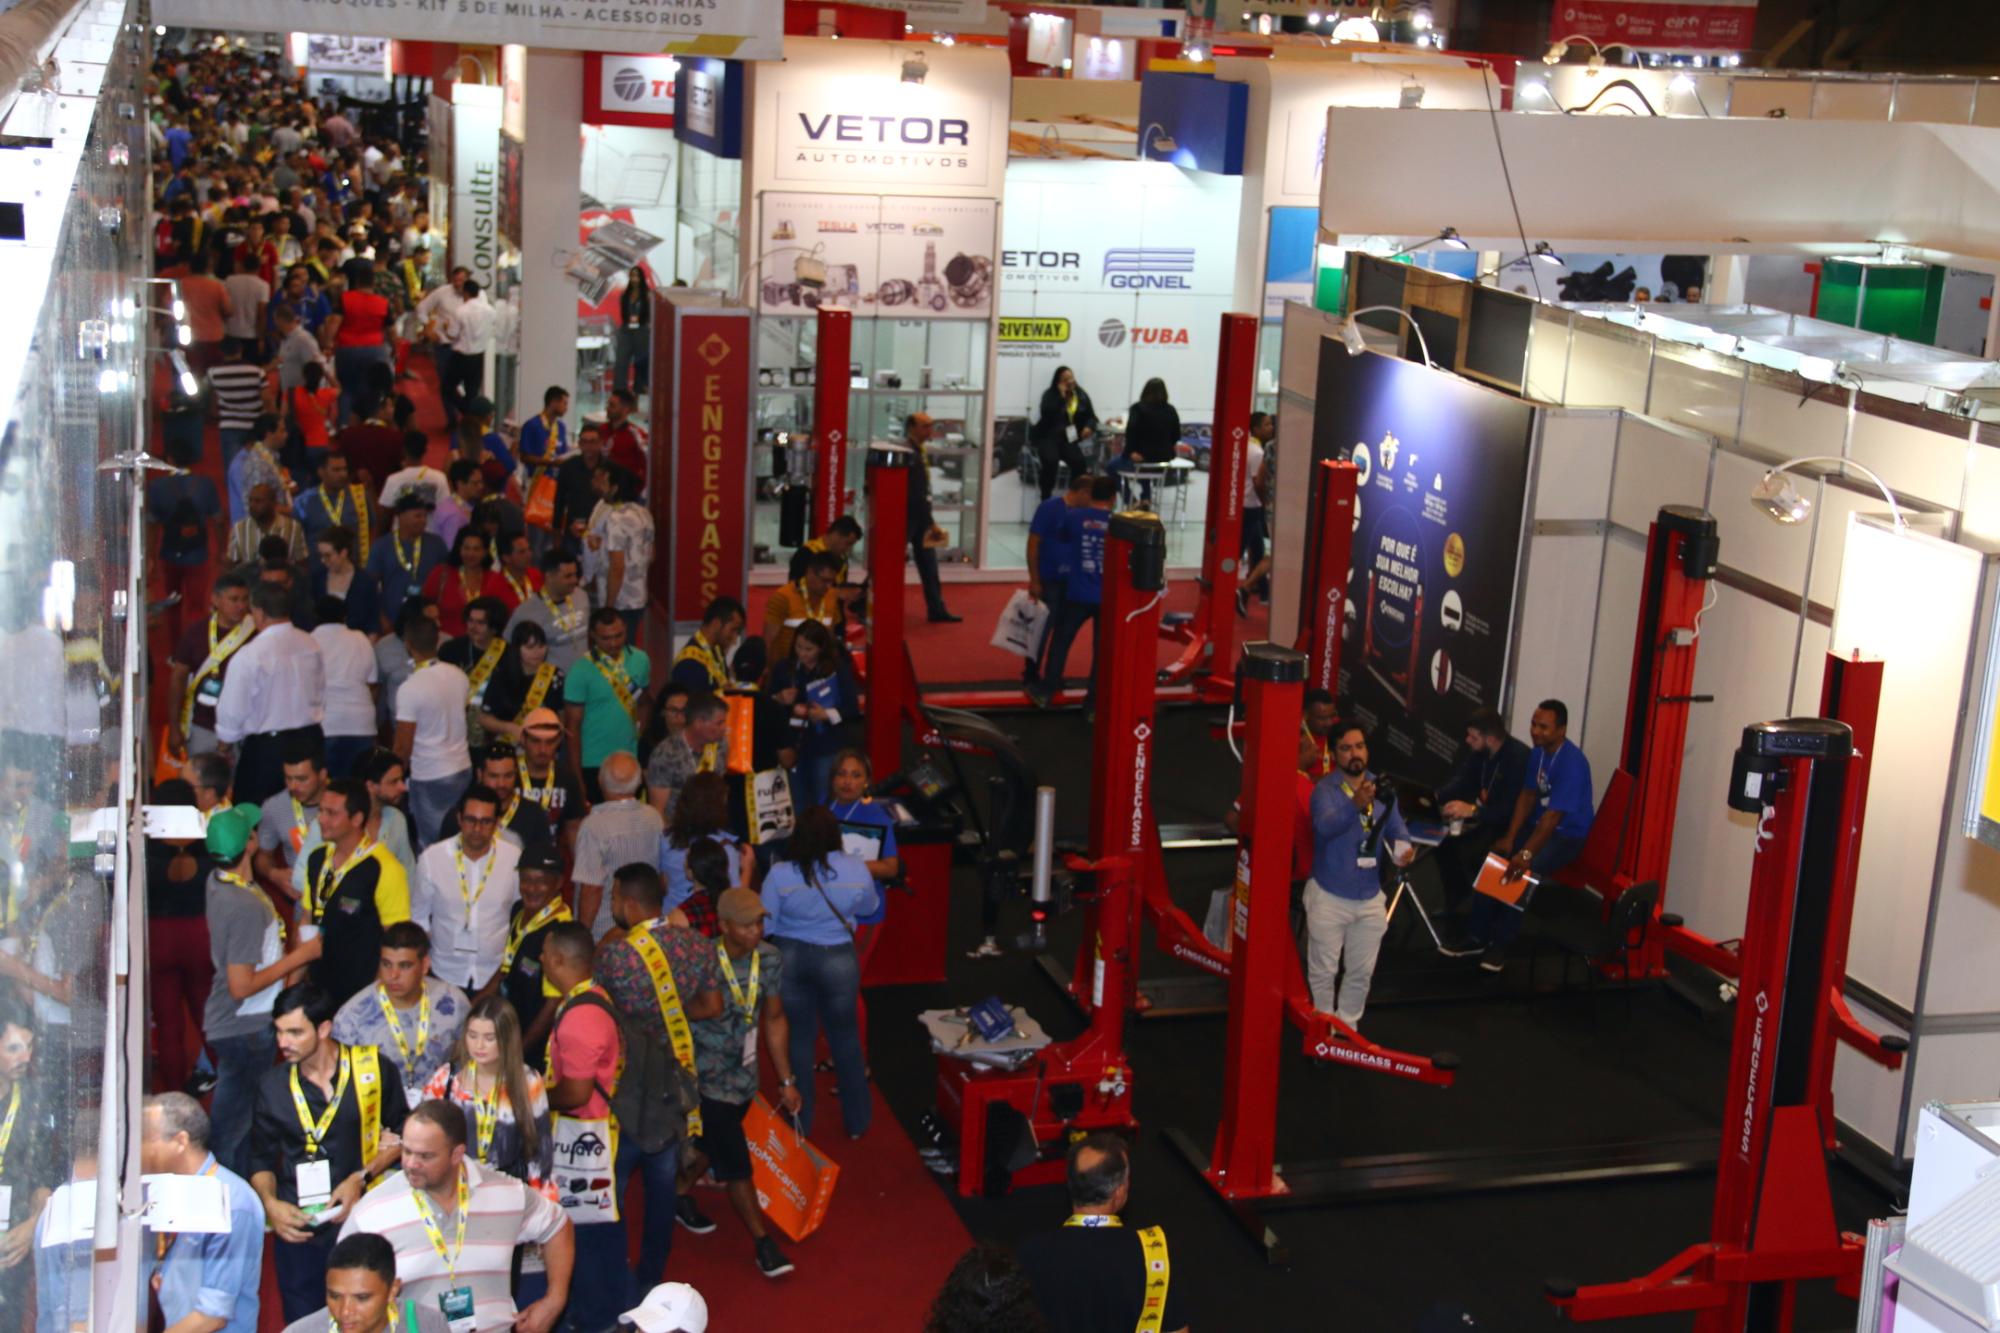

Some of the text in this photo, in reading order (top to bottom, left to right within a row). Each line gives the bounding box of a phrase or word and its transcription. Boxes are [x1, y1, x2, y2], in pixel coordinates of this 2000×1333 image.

[475, 3, 498, 15] DE
[505, 4, 564, 19] MILHA
[584, 8, 703, 27] ACESSORIOS
[798, 112, 969, 146] VETOR
[795, 152, 969, 168] AUTOMOTIVOS
[1110, 274, 1192, 289] GONEL
[1130, 327, 1190, 344] TUBA
[699, 375, 723, 608] ENGECASS
[1381, 535, 1396, 554] POR
[1396, 541, 1411, 560] QUE
[1390, 559, 1419, 584] MELHOR
[1378, 574, 1413, 602] ESCOLHA?
[1131, 743, 1146, 846] ENGECASS
[1329, 1046, 1392, 1069] ENGECASS
[1741, 1017, 1763, 1153] ENGECASS
